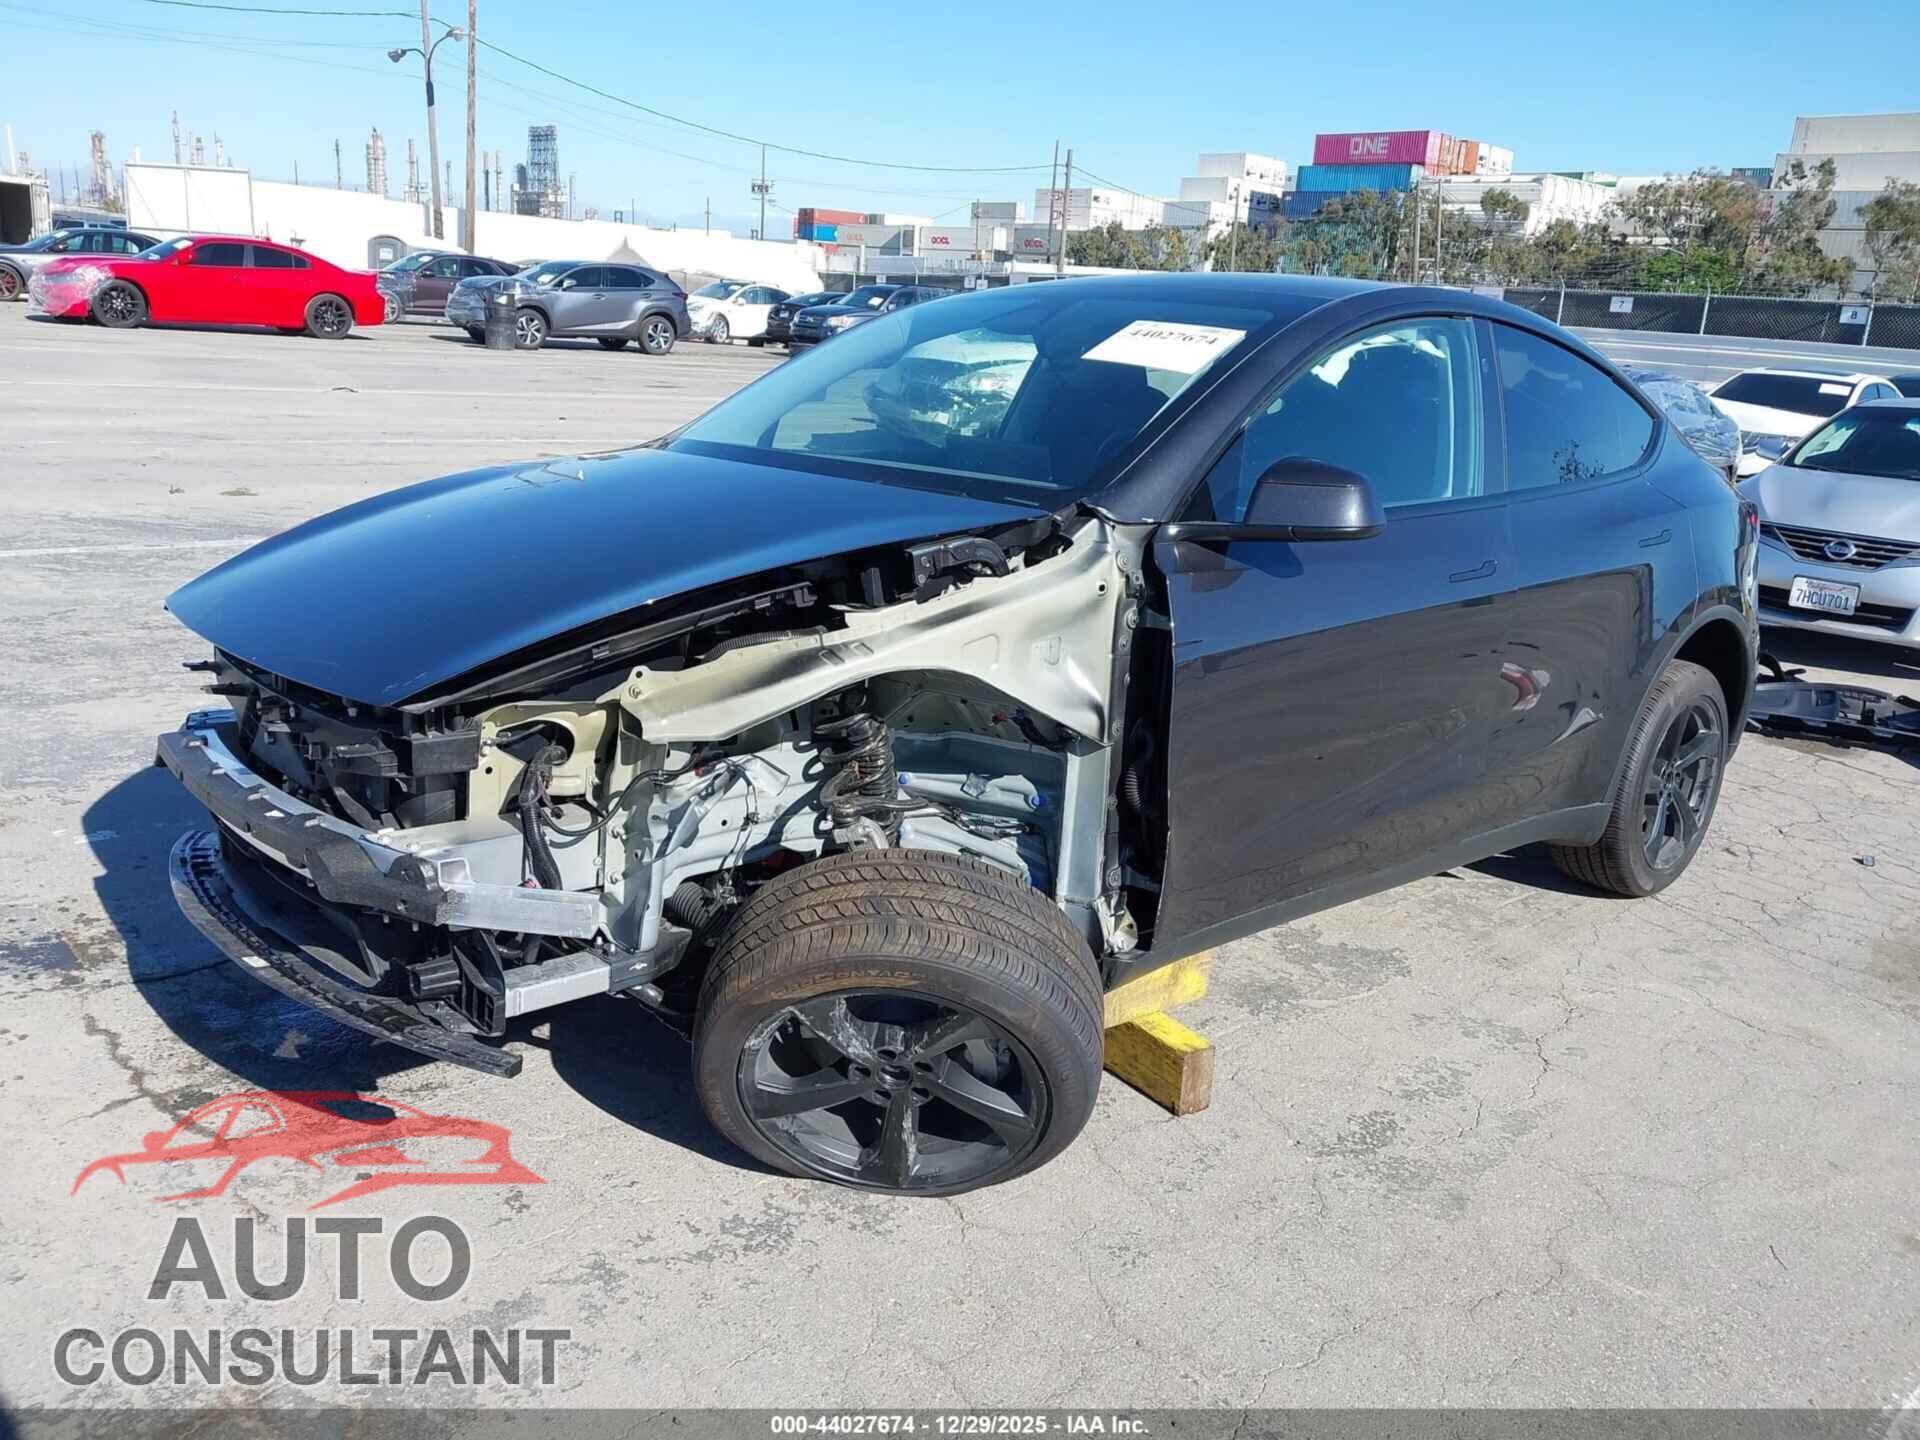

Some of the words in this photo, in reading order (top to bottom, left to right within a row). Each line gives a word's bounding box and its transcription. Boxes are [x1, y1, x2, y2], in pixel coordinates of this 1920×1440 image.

[1349, 136, 1389, 155] ONE
[1618, 300, 1625, 309] 7
[1851, 310, 1858, 320] 8
[1129, 328, 1219, 344] 44027674
[1796, 588, 1850, 610] 7HCU701
